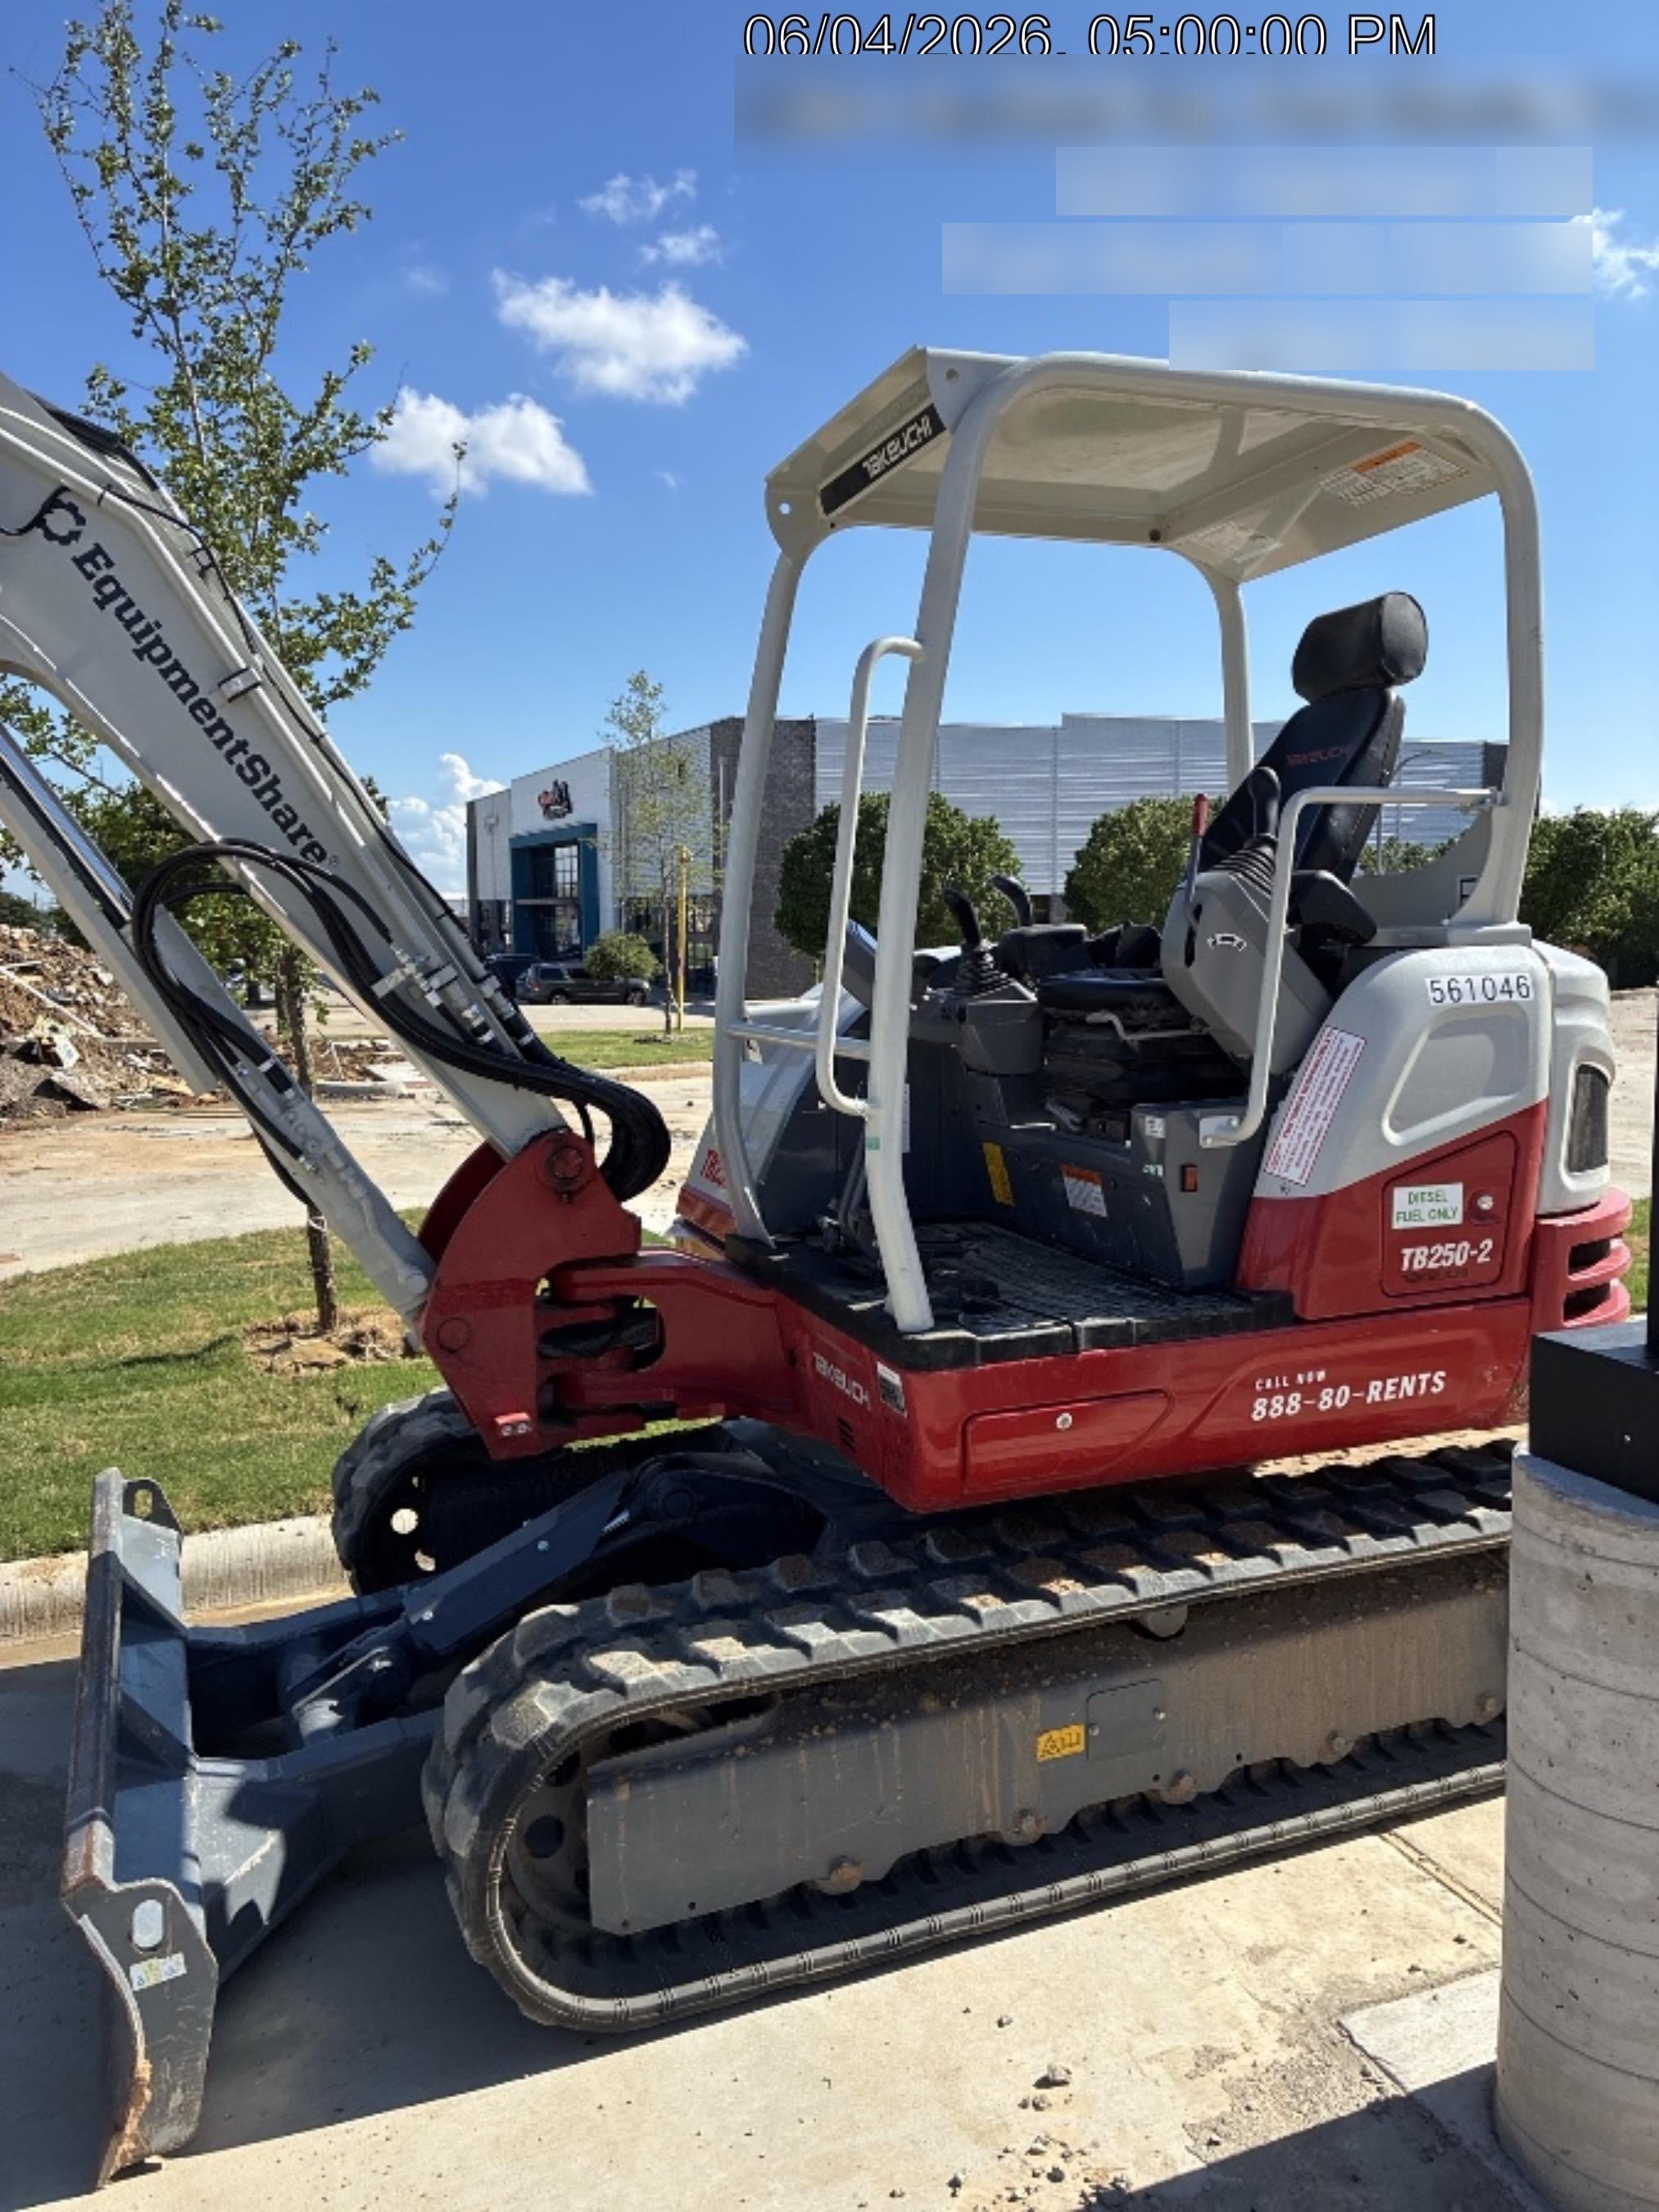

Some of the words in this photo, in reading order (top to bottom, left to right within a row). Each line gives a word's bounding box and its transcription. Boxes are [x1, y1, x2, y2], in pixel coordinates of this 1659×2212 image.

[71, 542, 329, 864] EquipmentShare
[1430, 974, 1530, 1004] 561046
[1407, 1189, 1448, 1205] DIESEL
[1395, 1208, 1426, 1224] FUEL
[1427, 1205, 1458, 1221] ONLY
[1400, 1238, 1494, 1272] TB250-2
[1255, 1375, 1290, 1391] CALL
[1296, 1368, 1326, 1385] NOW
[1250, 1370, 1448, 1421] 888-80-RENTS
